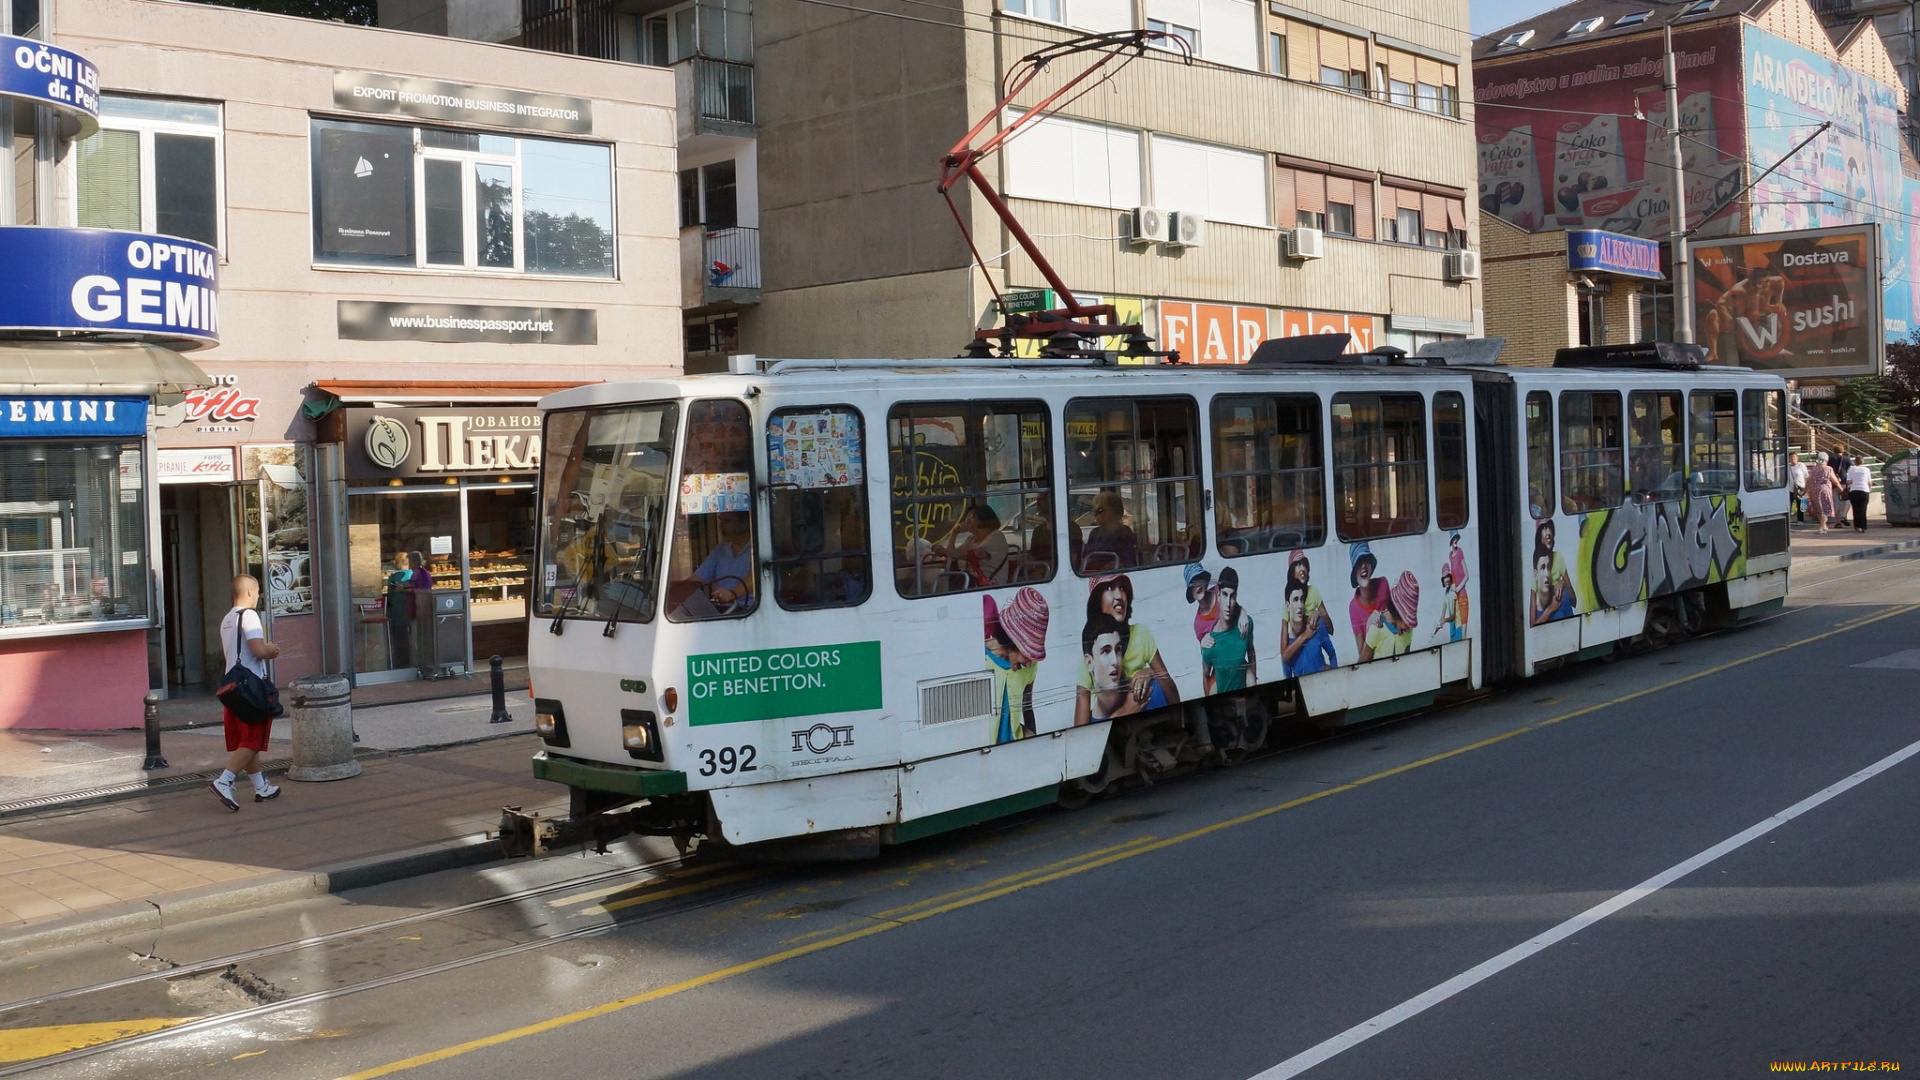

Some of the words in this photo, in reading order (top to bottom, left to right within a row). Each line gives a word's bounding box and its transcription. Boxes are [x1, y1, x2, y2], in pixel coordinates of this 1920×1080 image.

[15, 45, 73, 79] OČNI
[1474, 76, 1557, 101] adovoljstvo
[1559, 75, 1570, 89] u
[1571, 64, 1620, 87] malim
[1622, 46, 1716, 78] zalogjima!
[48, 79, 71, 101] dr.
[353, 86, 397, 101] EXPORT
[398, 91, 463, 108] PROMOTION
[464, 98, 515, 114] BUSINESS
[517, 104, 579, 121] INTEGRATOR
[1572, 131, 1606, 150] Čoko
[128, 240, 215, 281] OPTIKA
[1783, 250, 1849, 267] Dostava
[1019, 292, 1040, 300] COLORS
[390, 315, 554, 332] www.businesspassport.net
[1736, 312, 1778, 350] W
[1793, 294, 1855, 332] sushi
[0, 400, 116, 422] EMINI
[191, 460, 232, 473] kifla
[271, 591, 304, 605] ЕКАРА
[691, 656, 762, 677] UNITED
[767, 650, 841, 671] COLORS
[692, 681, 717, 699] OF
[723, 673, 827, 696] BENETTON.
[698, 744, 757, 777] 392
